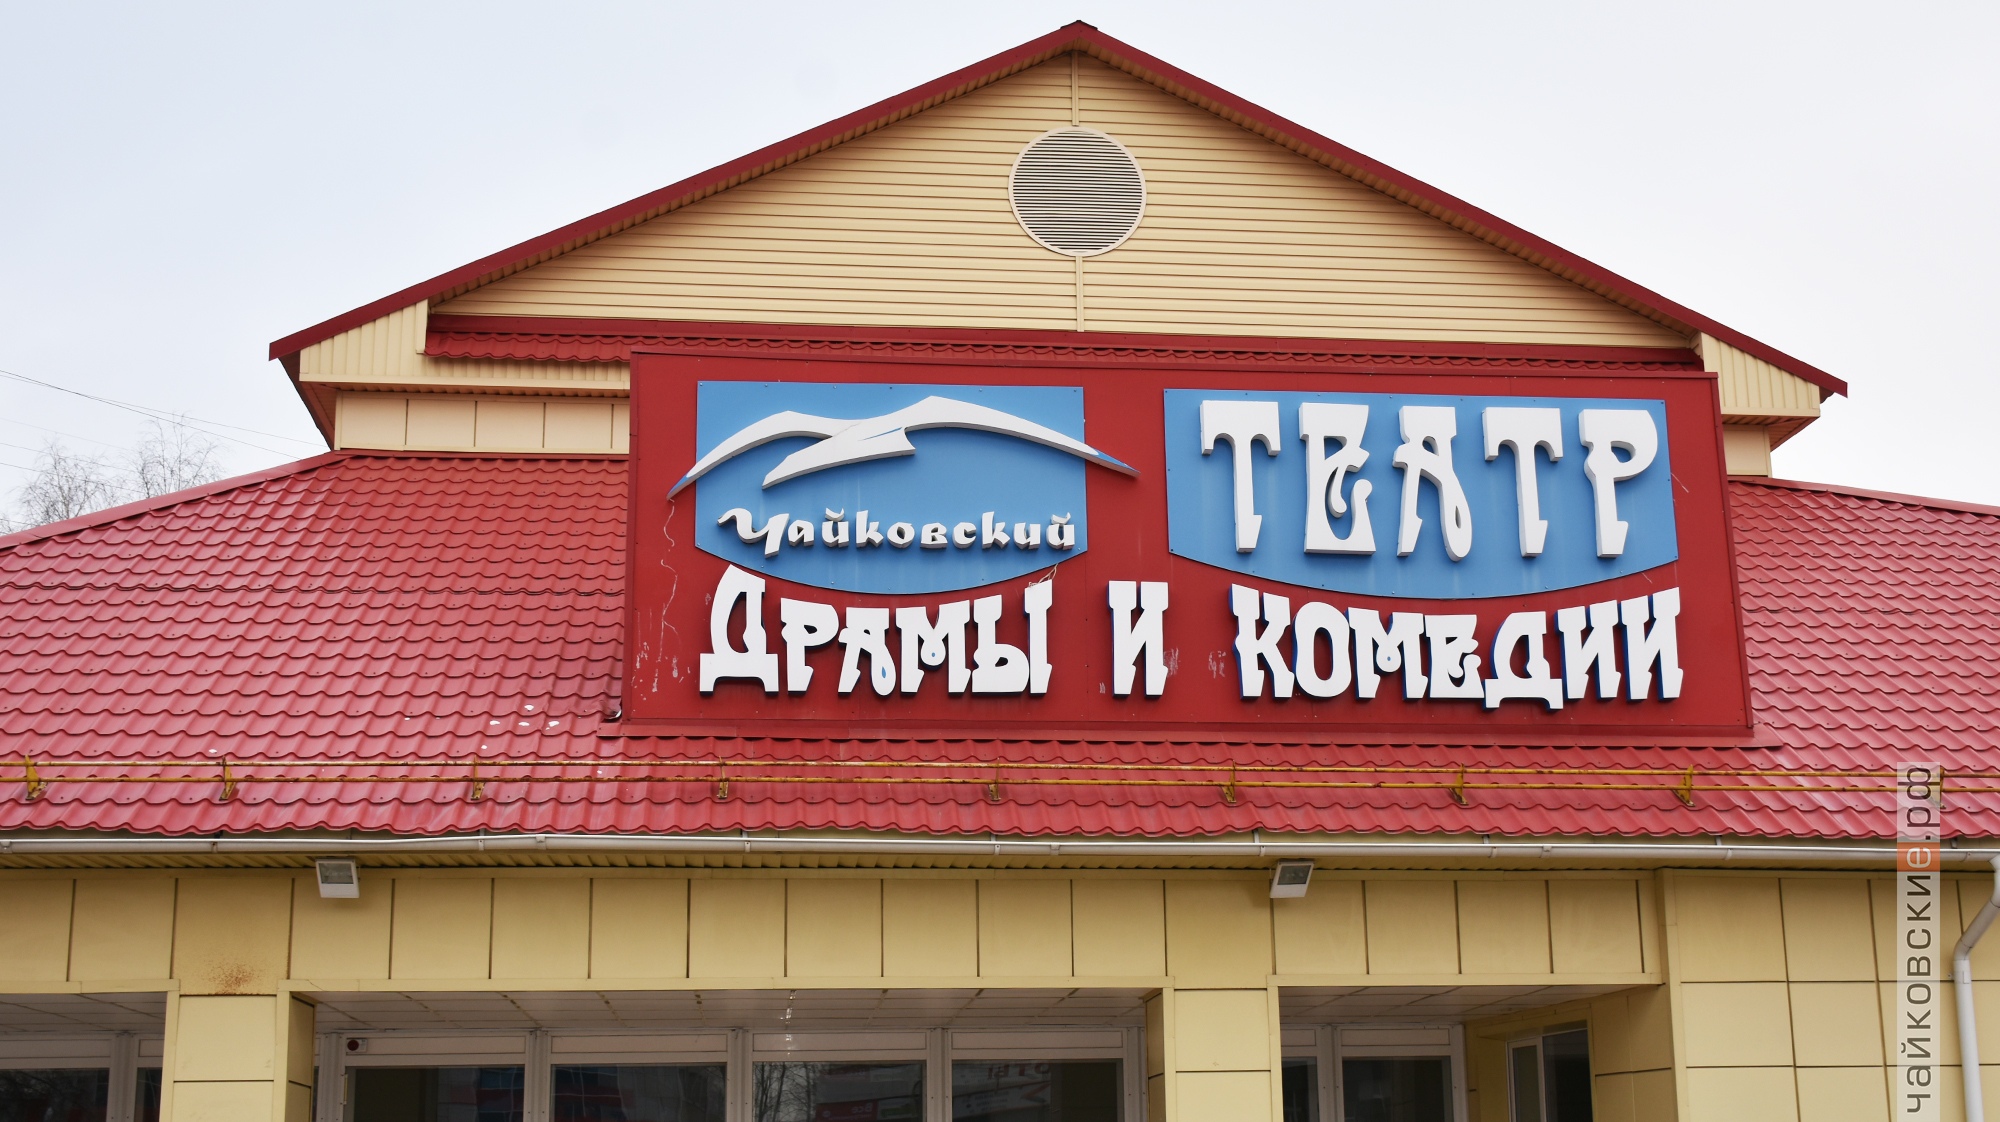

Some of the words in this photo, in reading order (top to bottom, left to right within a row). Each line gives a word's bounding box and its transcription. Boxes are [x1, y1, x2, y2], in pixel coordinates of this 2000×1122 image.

[717, 507, 1075, 557] Чайковский
[1199, 400, 1658, 562] ТЕАТР
[699, 564, 1053, 697] ДРАМЫ
[1108, 580, 1169, 697] И
[1230, 583, 1684, 710] КОМЕДИИ
